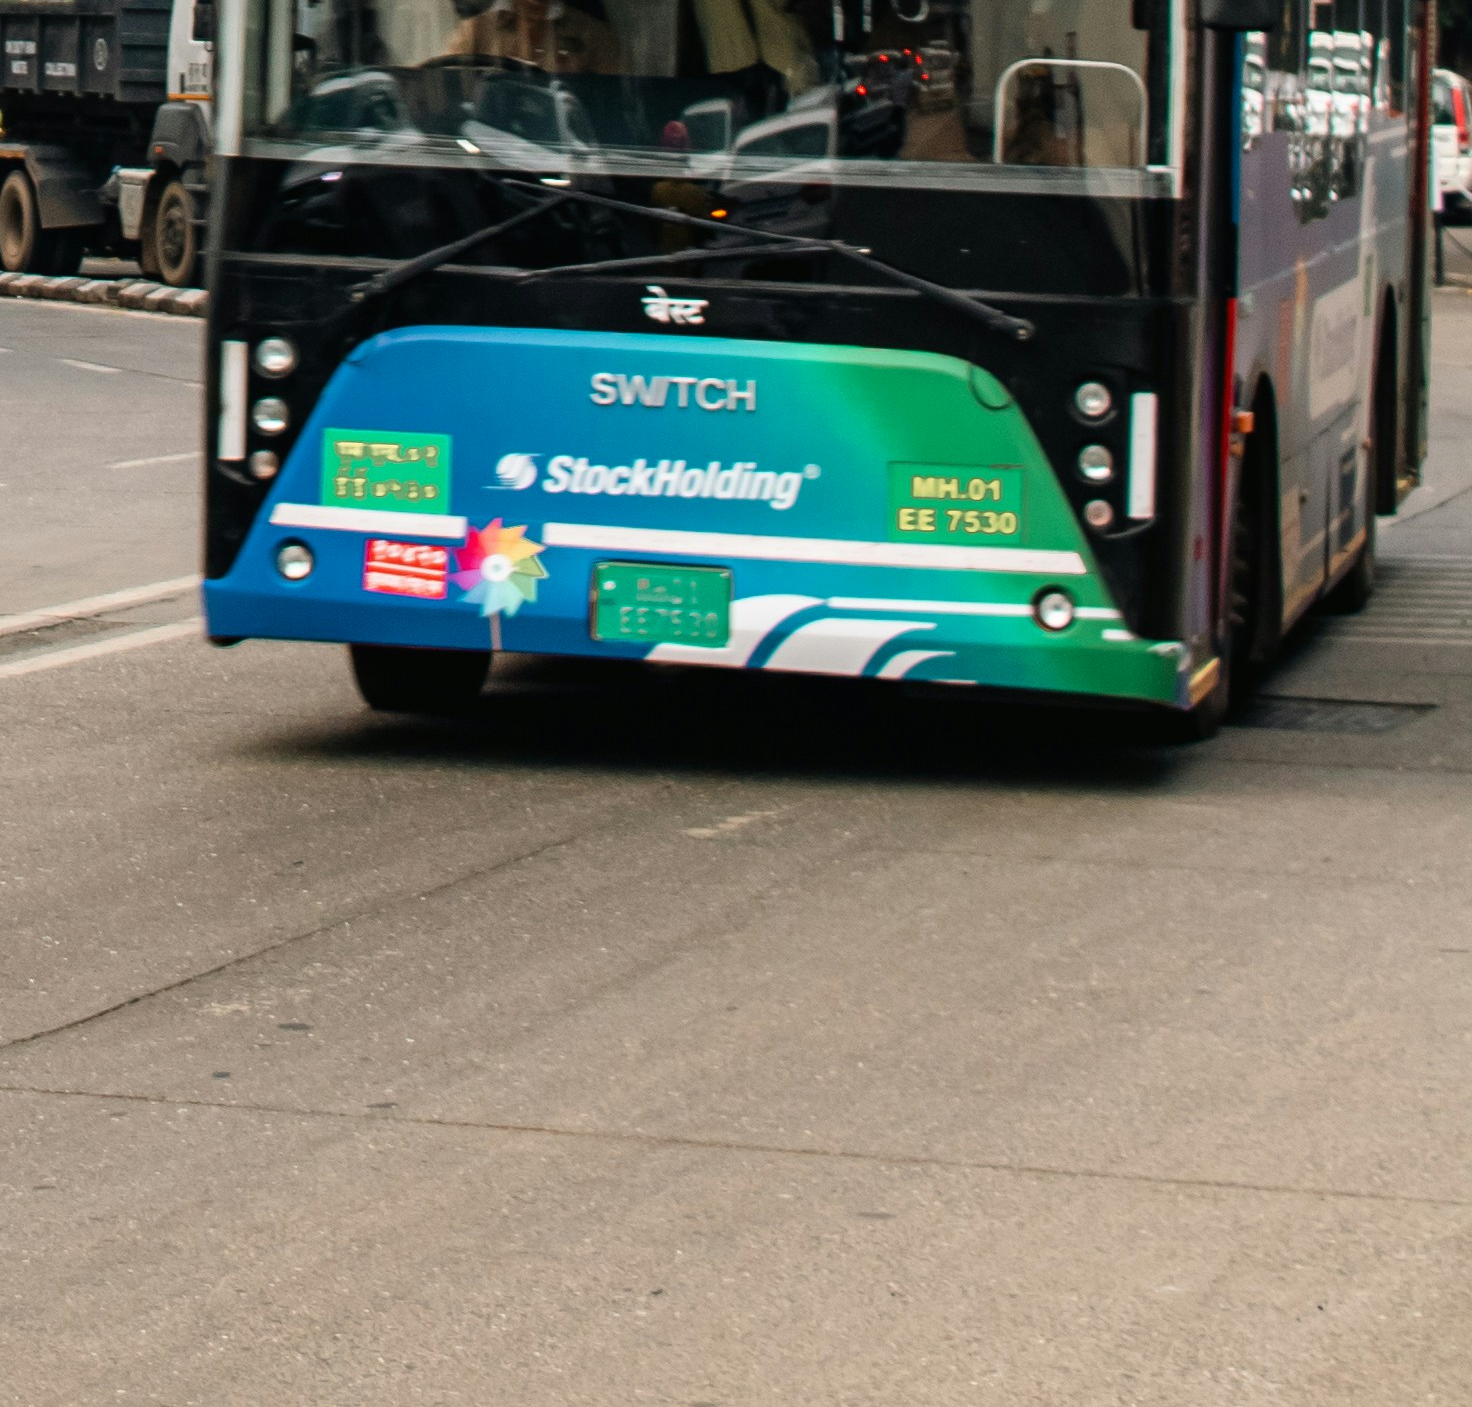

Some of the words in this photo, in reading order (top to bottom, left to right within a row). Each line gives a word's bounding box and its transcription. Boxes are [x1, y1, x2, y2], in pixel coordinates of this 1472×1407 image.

[641, 285, 709, 325] बेस्ट
[589, 372, 757, 412] SWITCH
[542, 454, 804, 511] StockHolding
[911, 475, 1002, 502] MH.01
[897, 507, 937, 533] EE
[945, 509, 1018, 535] 7530
